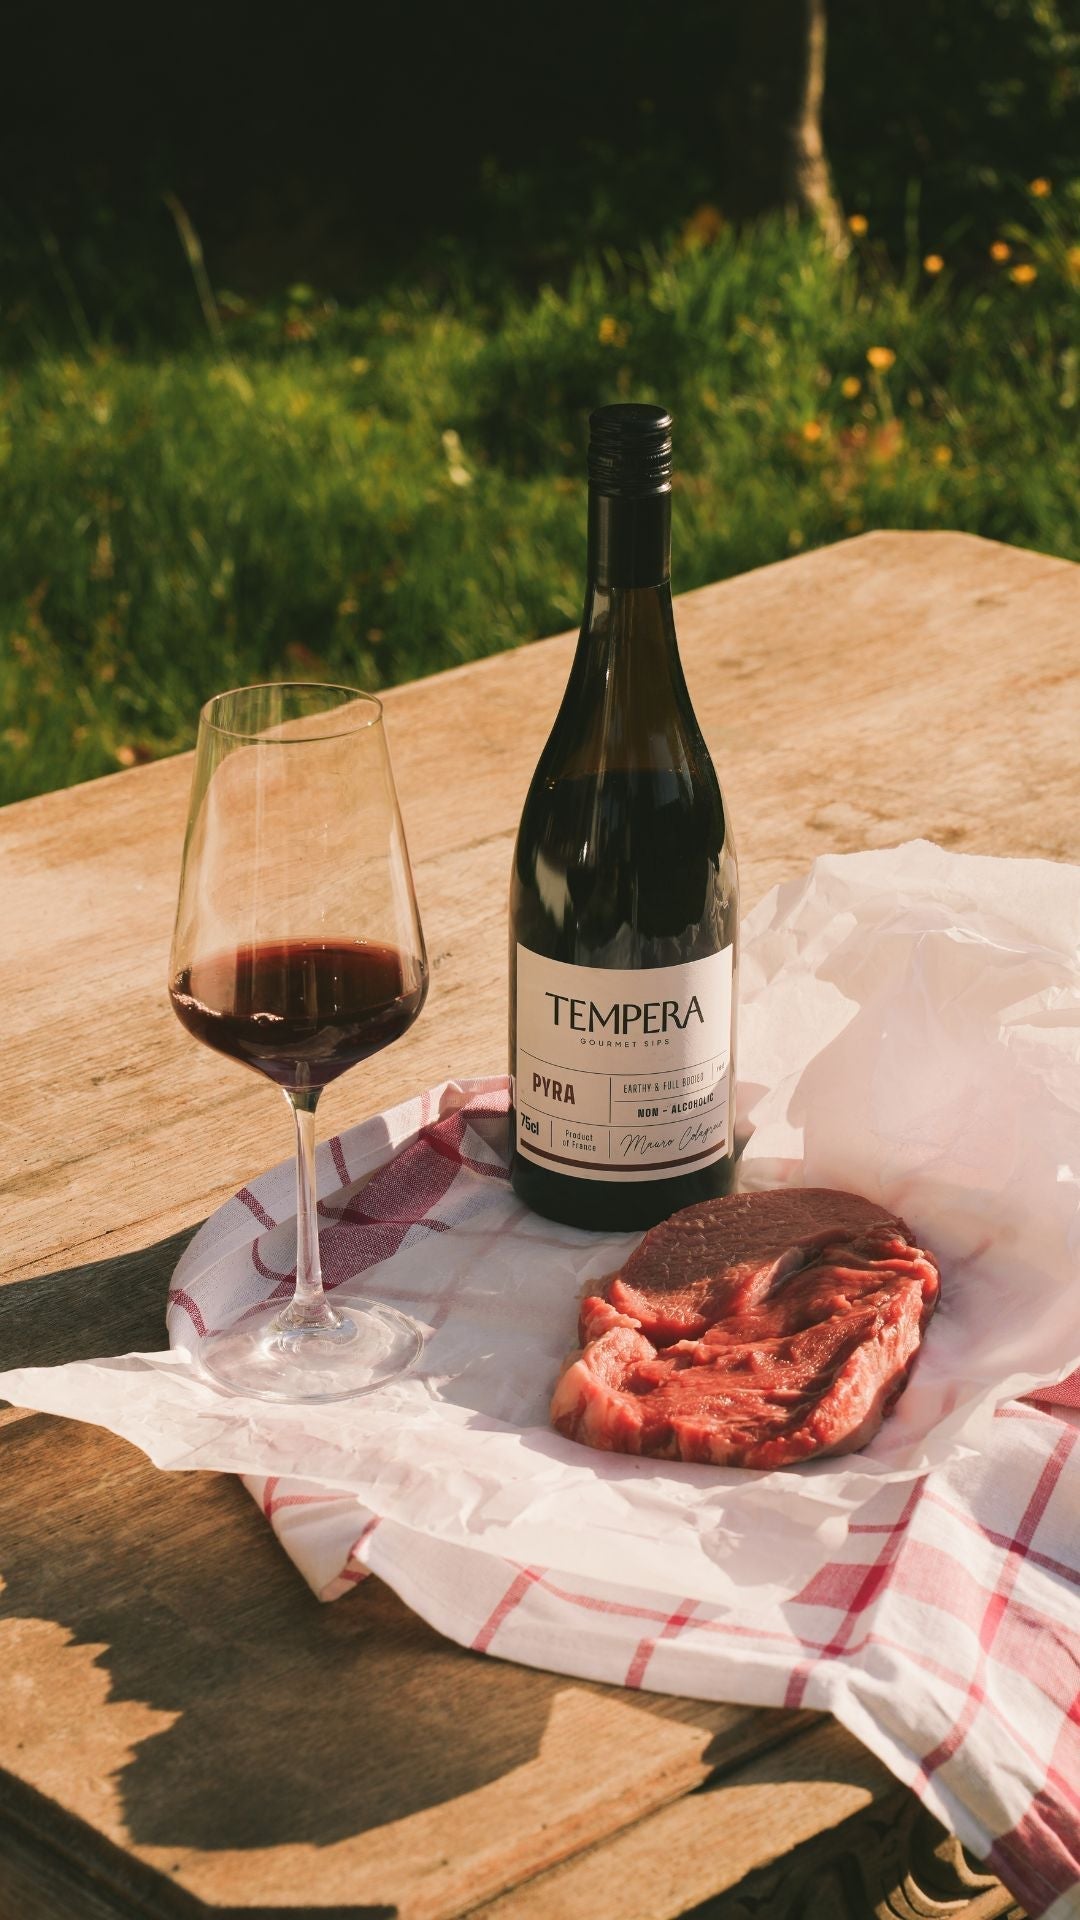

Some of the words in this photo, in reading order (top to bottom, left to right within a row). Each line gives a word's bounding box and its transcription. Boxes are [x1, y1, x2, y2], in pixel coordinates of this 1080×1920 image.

[545, 991, 705, 1035] TEMPERA
[580, 1037, 637, 1048] GOURMET
[644, 1038, 670, 1047] SIPS
[532, 1072, 576, 1105] PYRA
[623, 1083, 652, 1094] EARTHY
[654, 1082, 660, 1092] &
[663, 1080, 680, 1090] FULL
[637, 1107, 659, 1118] NON
[671, 1092, 714, 1114] ALCOHOLIC
[520, 1111, 539, 1136] 75cl
[565, 1129, 593, 1141] Product
[562, 1139, 570, 1147] of
[572, 1140, 596, 1152] France
